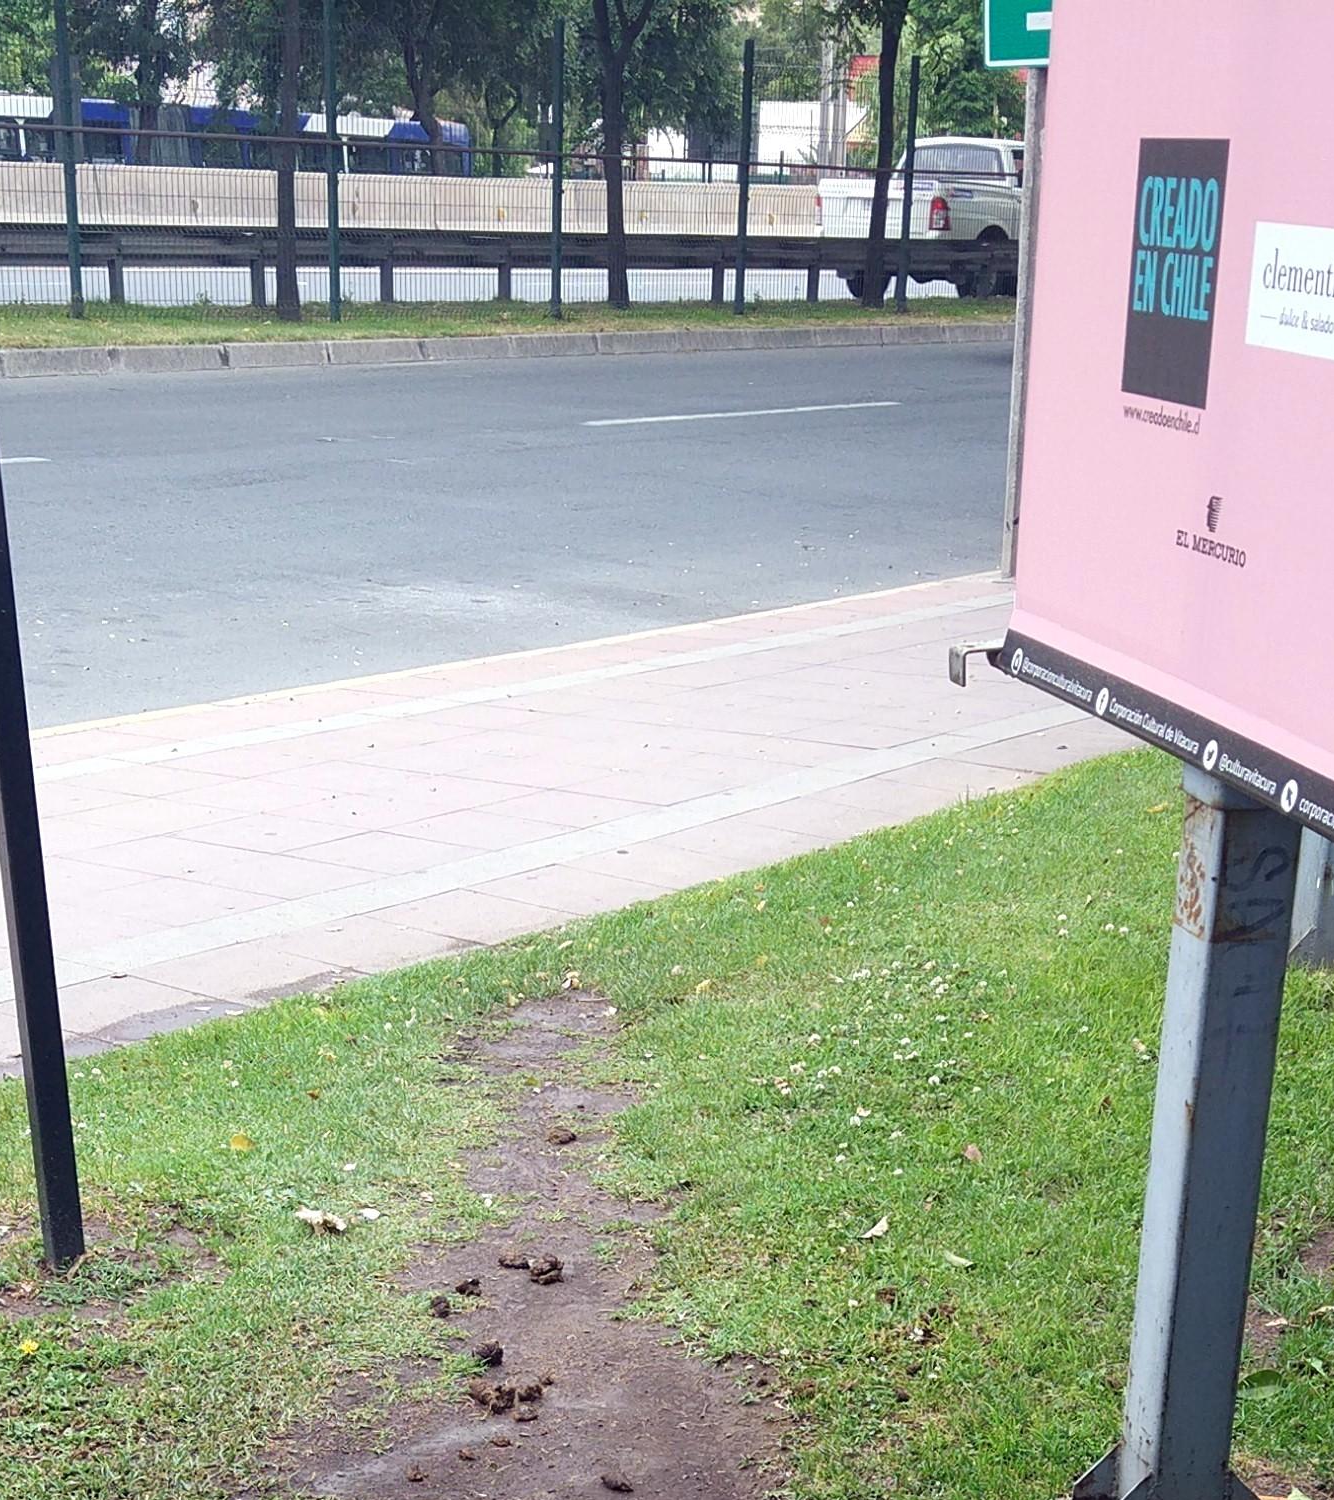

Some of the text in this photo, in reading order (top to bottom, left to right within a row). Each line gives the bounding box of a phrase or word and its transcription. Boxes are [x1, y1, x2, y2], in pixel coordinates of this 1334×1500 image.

[1139, 176, 1219, 252] CREADO
[1133, 249, 1214, 321] EN CHILE
[1278, 306, 1300, 328] dulce
[1310, 312, 1334, 335] salado
[1123, 404, 1202, 435] www.creadoenchile.cl
[1175, 529, 1247, 568] EL MERCURIO
[1109, 697, 1200, 754] Corporación Cultural de Vitacura
[1218, 753, 1277, 795] @culturavitacura
